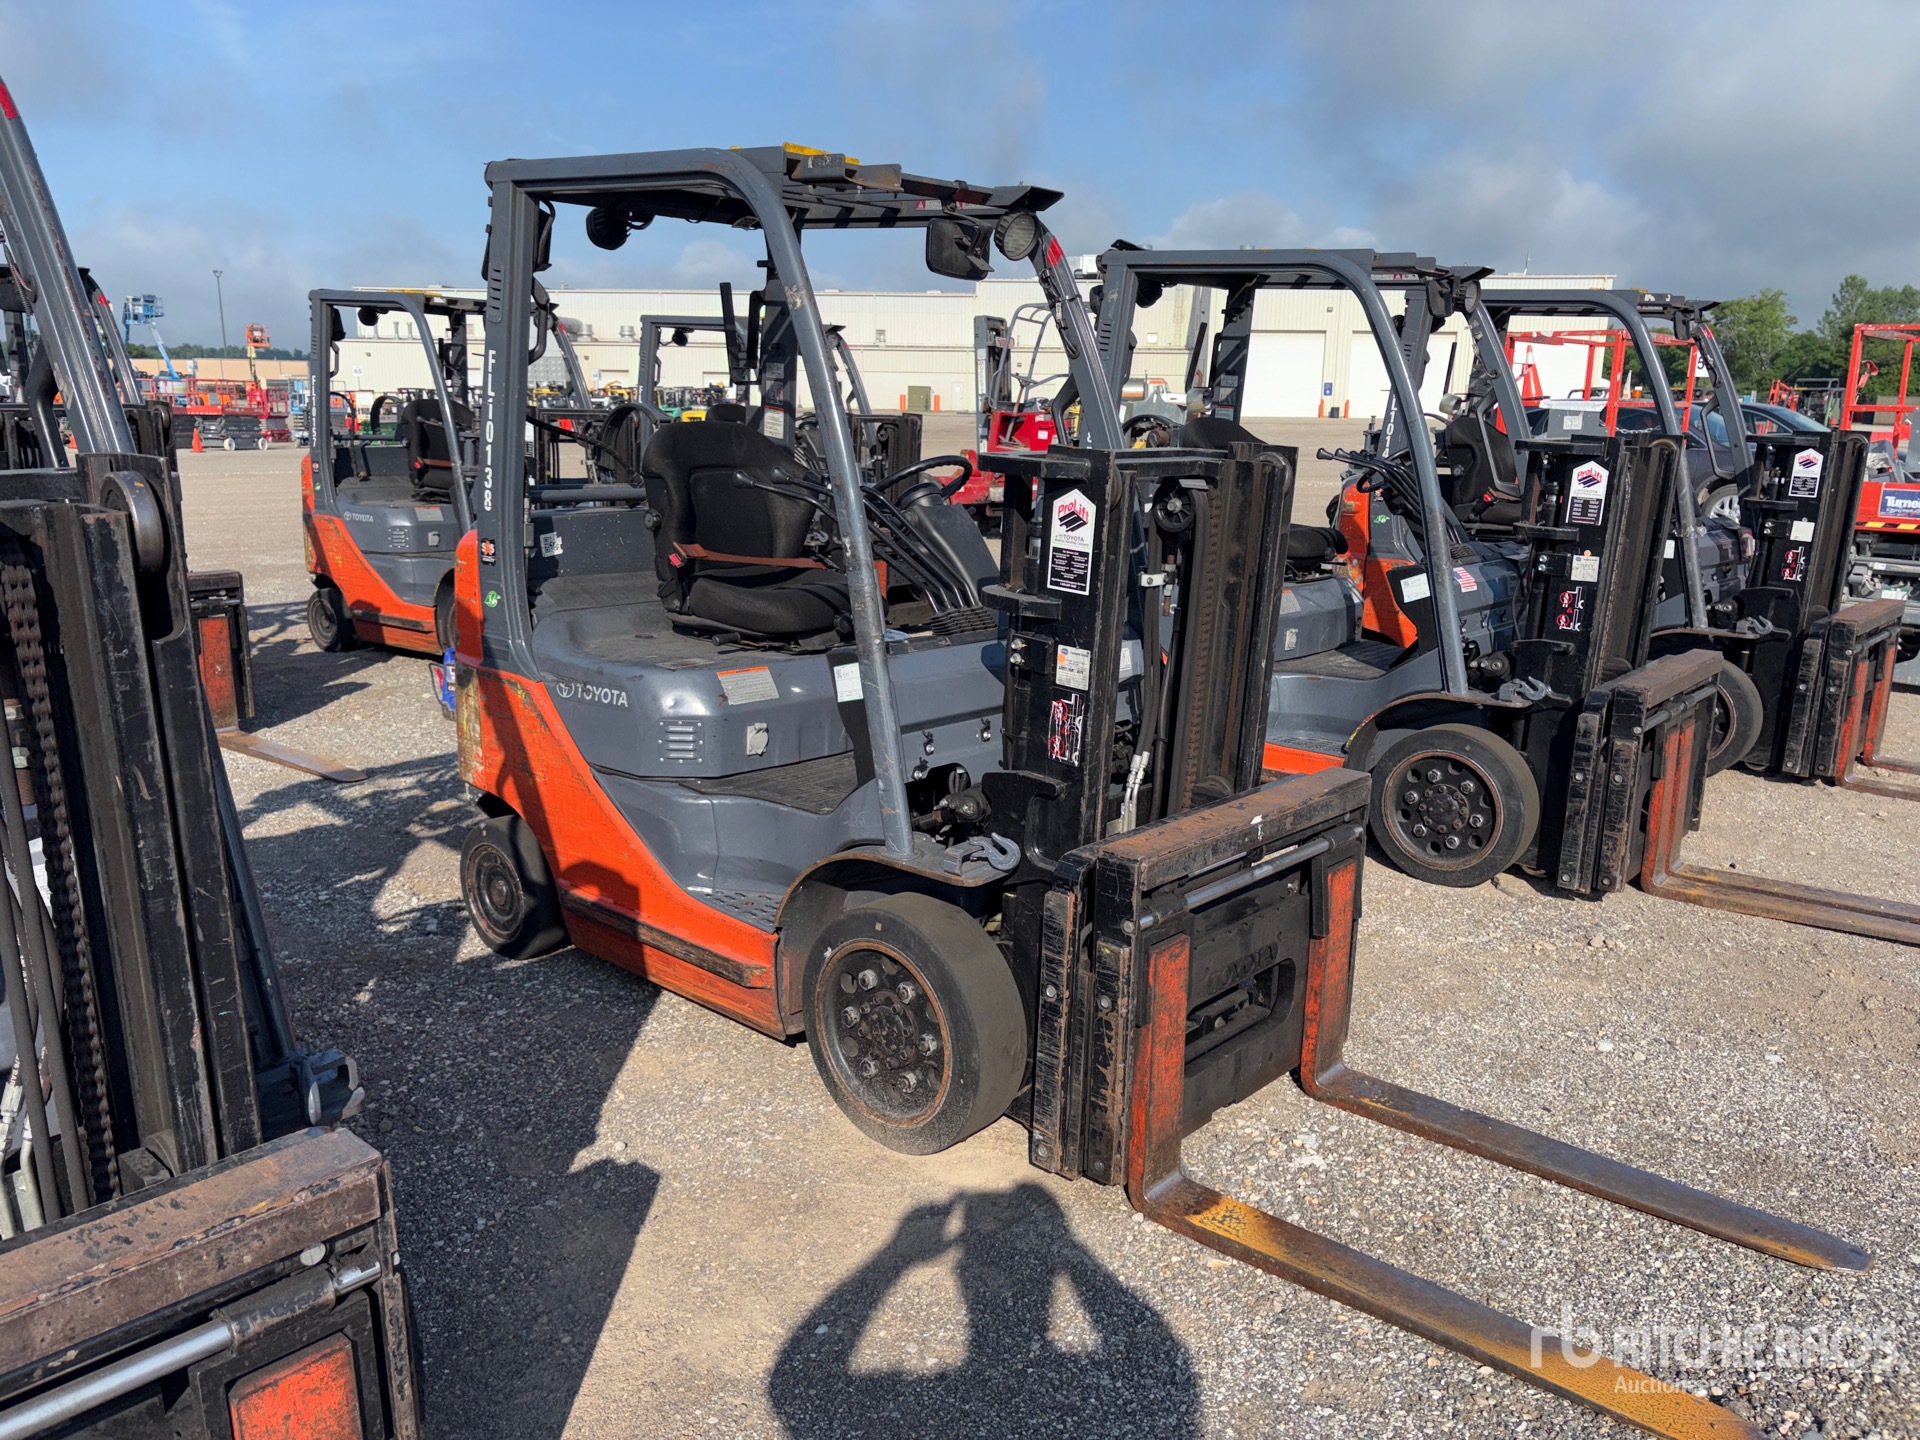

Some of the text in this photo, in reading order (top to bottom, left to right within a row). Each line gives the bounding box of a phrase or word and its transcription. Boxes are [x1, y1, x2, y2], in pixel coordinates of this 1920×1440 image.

[1382, 394, 1398, 458] L1014
[1885, 496, 1920, 508] Turne
[352, 513, 374, 523] TOYOTA
[1058, 499, 1089, 524] ProLift
[1063, 534, 1085, 542] TOYOTA
[576, 682, 629, 708] TOYOTA
